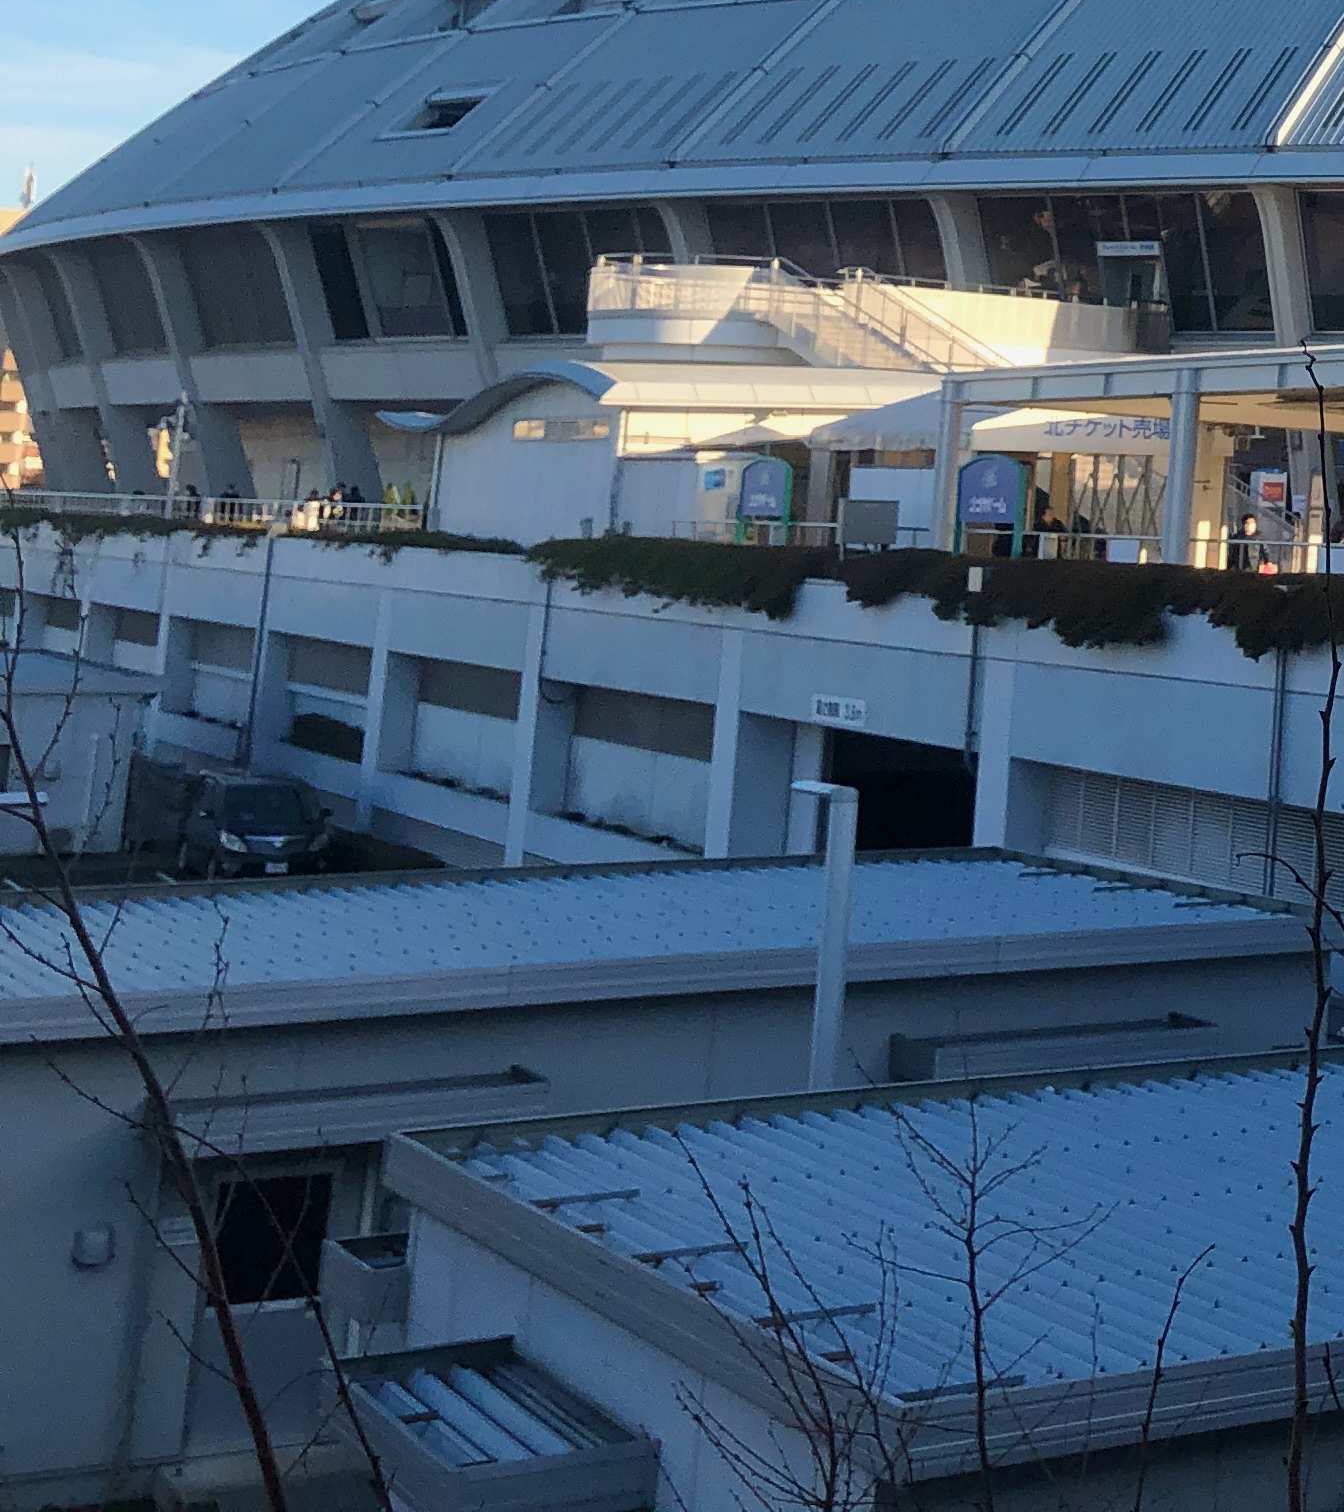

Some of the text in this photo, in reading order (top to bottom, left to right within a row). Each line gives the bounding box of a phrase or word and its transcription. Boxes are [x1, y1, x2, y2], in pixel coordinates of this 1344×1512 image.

[1043, 419, 1170, 440] 北チケット売場
